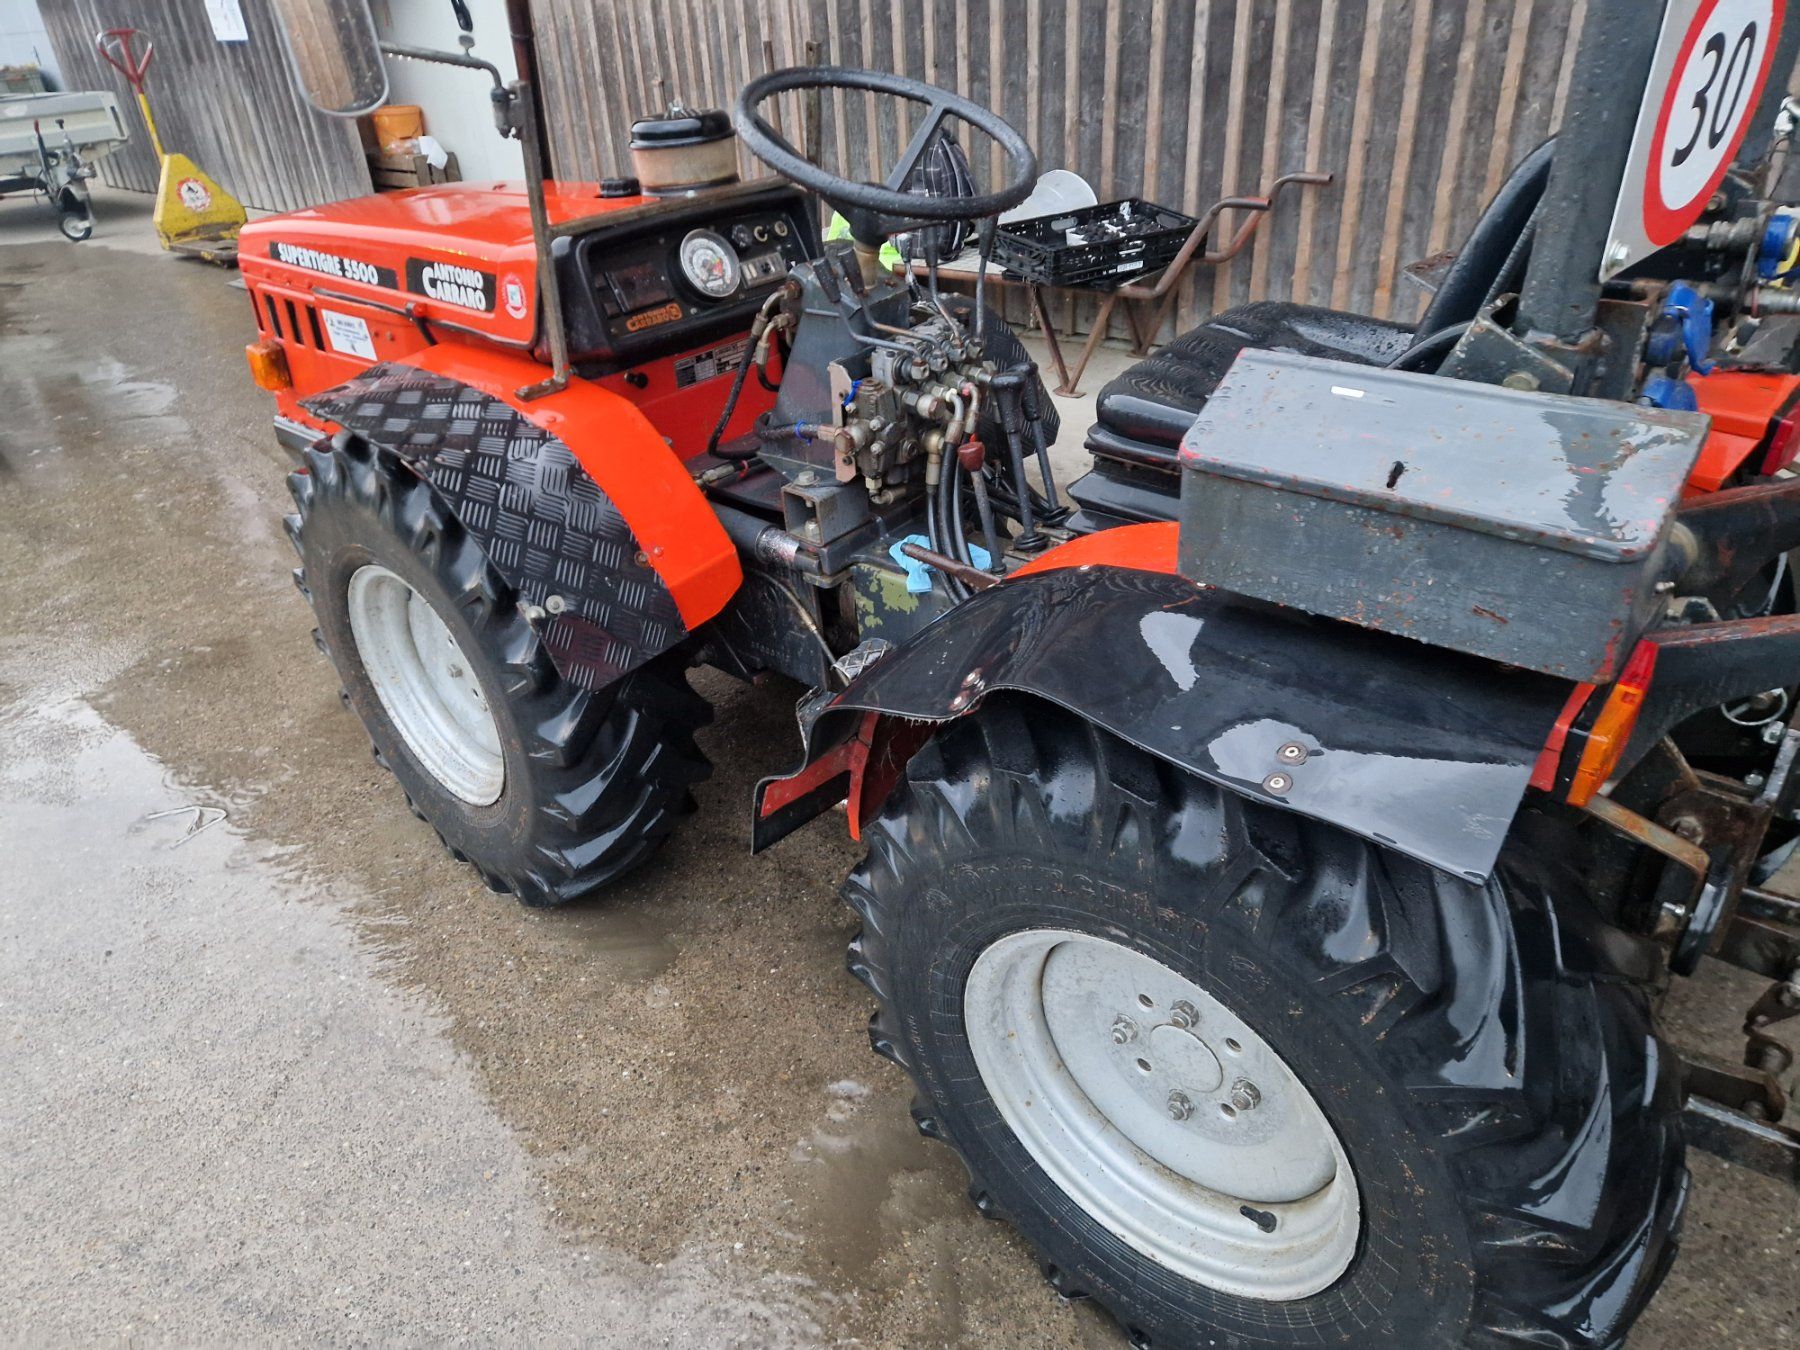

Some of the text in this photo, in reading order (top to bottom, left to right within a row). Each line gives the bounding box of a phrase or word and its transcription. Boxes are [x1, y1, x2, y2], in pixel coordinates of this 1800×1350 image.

[1670, 20, 1757, 168] 30
[277, 242, 379, 285] SUPERTIGRE 5500
[433, 262, 484, 290] ANTONIO
[422, 266, 487, 312] CARRARO
[626, 313, 670, 333] CARRARO
